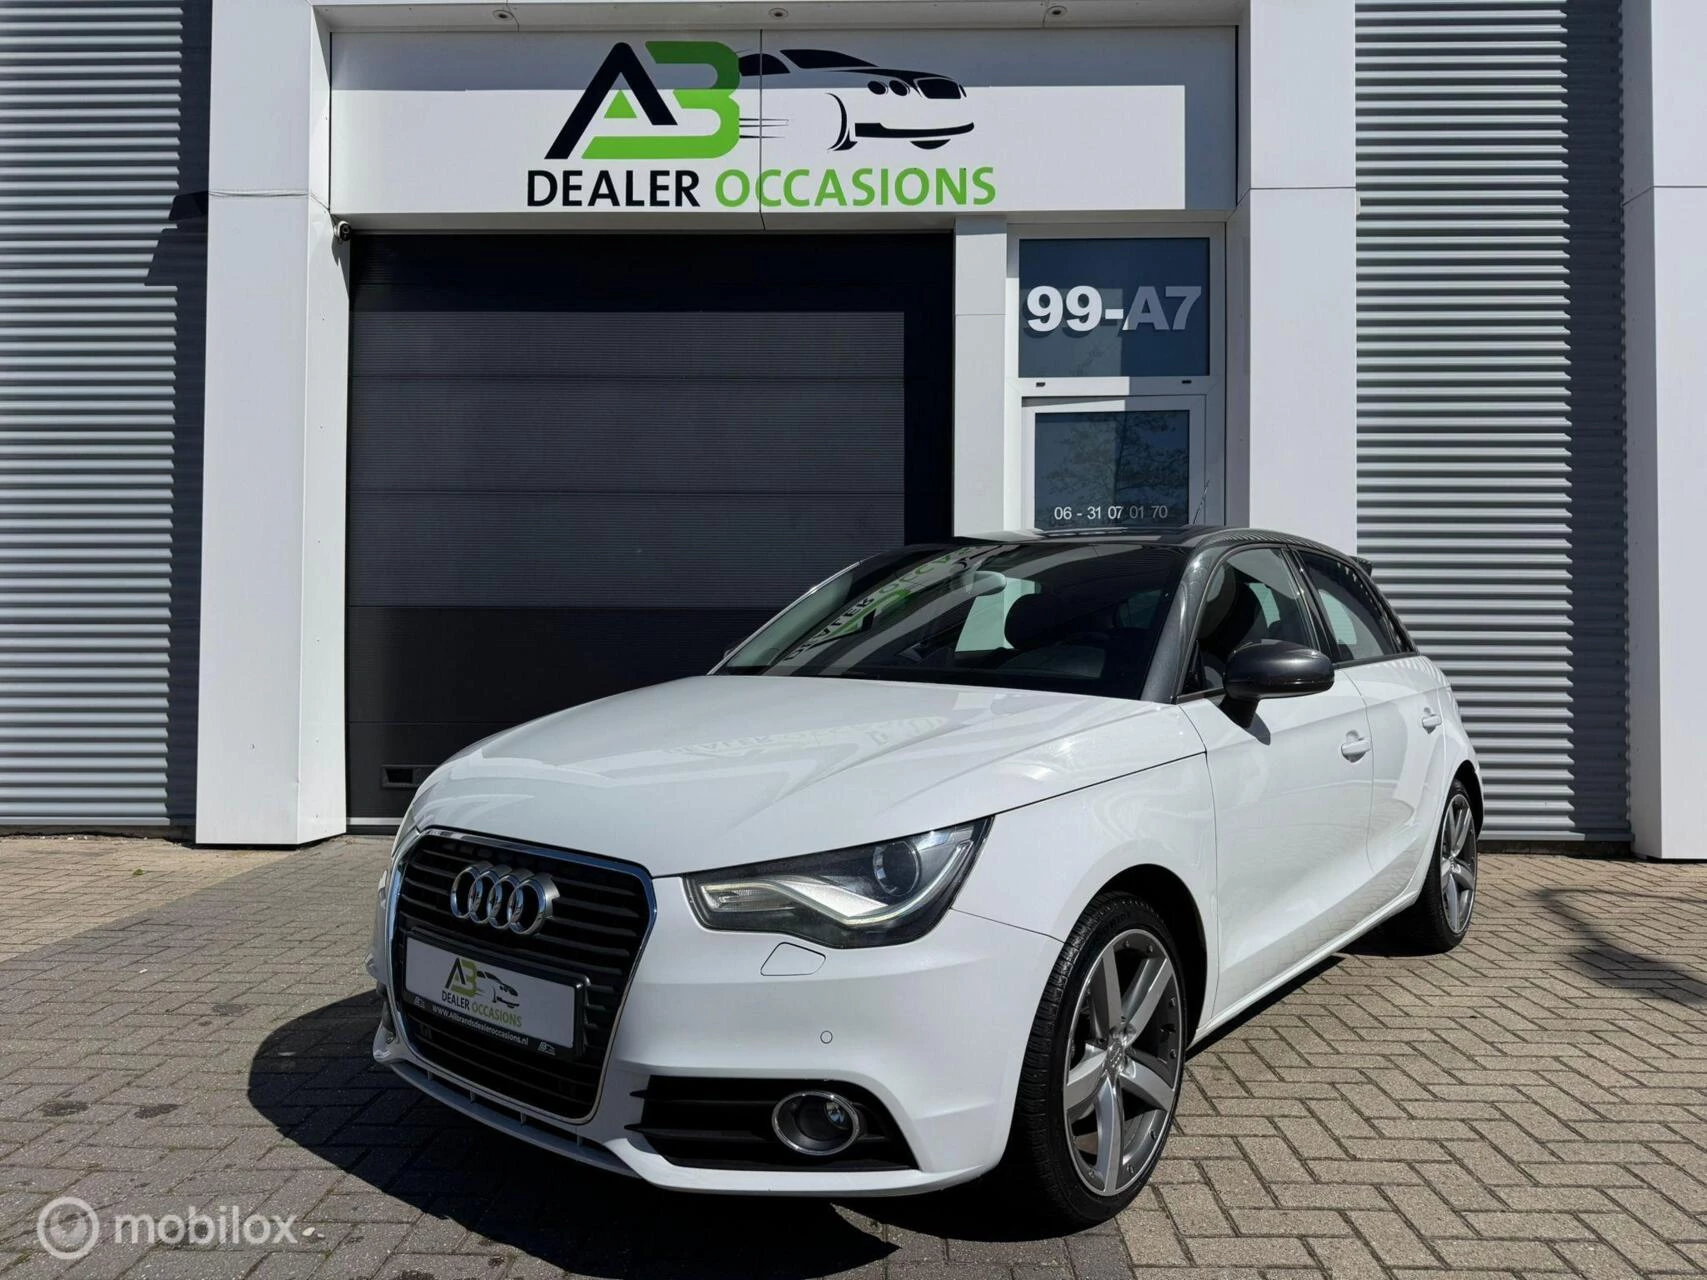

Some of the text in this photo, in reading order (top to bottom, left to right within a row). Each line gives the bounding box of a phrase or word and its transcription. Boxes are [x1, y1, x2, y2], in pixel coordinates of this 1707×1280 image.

[527, 166, 996, 207] DEALER OCCASIONS
[1026, 285, 1202, 332] 99-A7
[1054, 506, 1072, 520] 06
[1087, 506, 1101, 519] 31
[1107, 505, 1123, 519] 07
[1129, 505, 1144, 519] 01
[1151, 504, 1168, 519] 70
[441, 990, 470, 1011] DEALER
[471, 1002, 522, 1028] OCCASIONS
